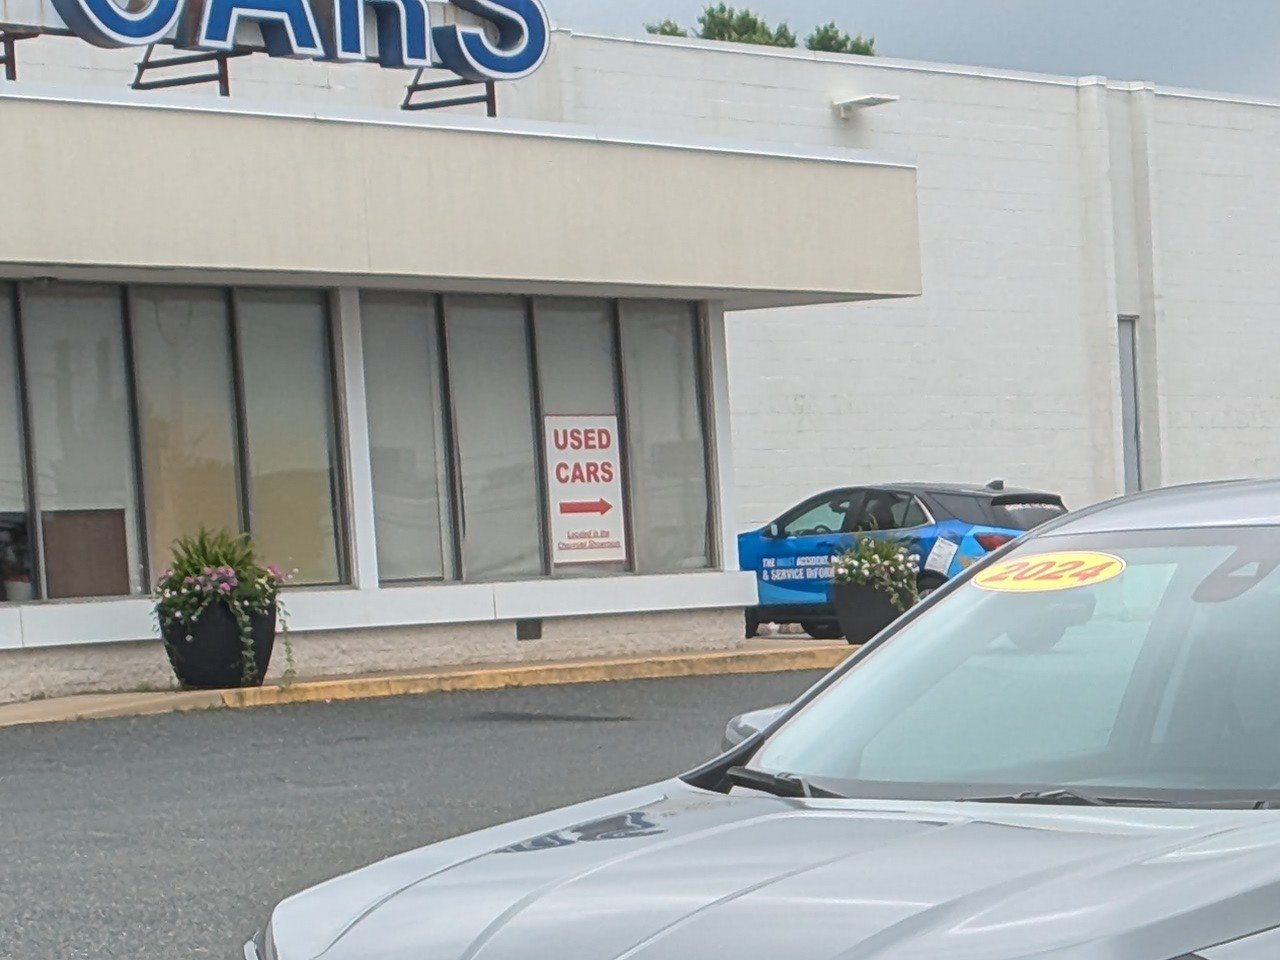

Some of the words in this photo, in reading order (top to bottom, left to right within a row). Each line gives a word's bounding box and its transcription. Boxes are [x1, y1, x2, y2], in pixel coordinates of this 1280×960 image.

[553, 428, 612, 450] USED
[555, 461, 614, 484] CARS
[980, 560, 1117, 582] 2024
